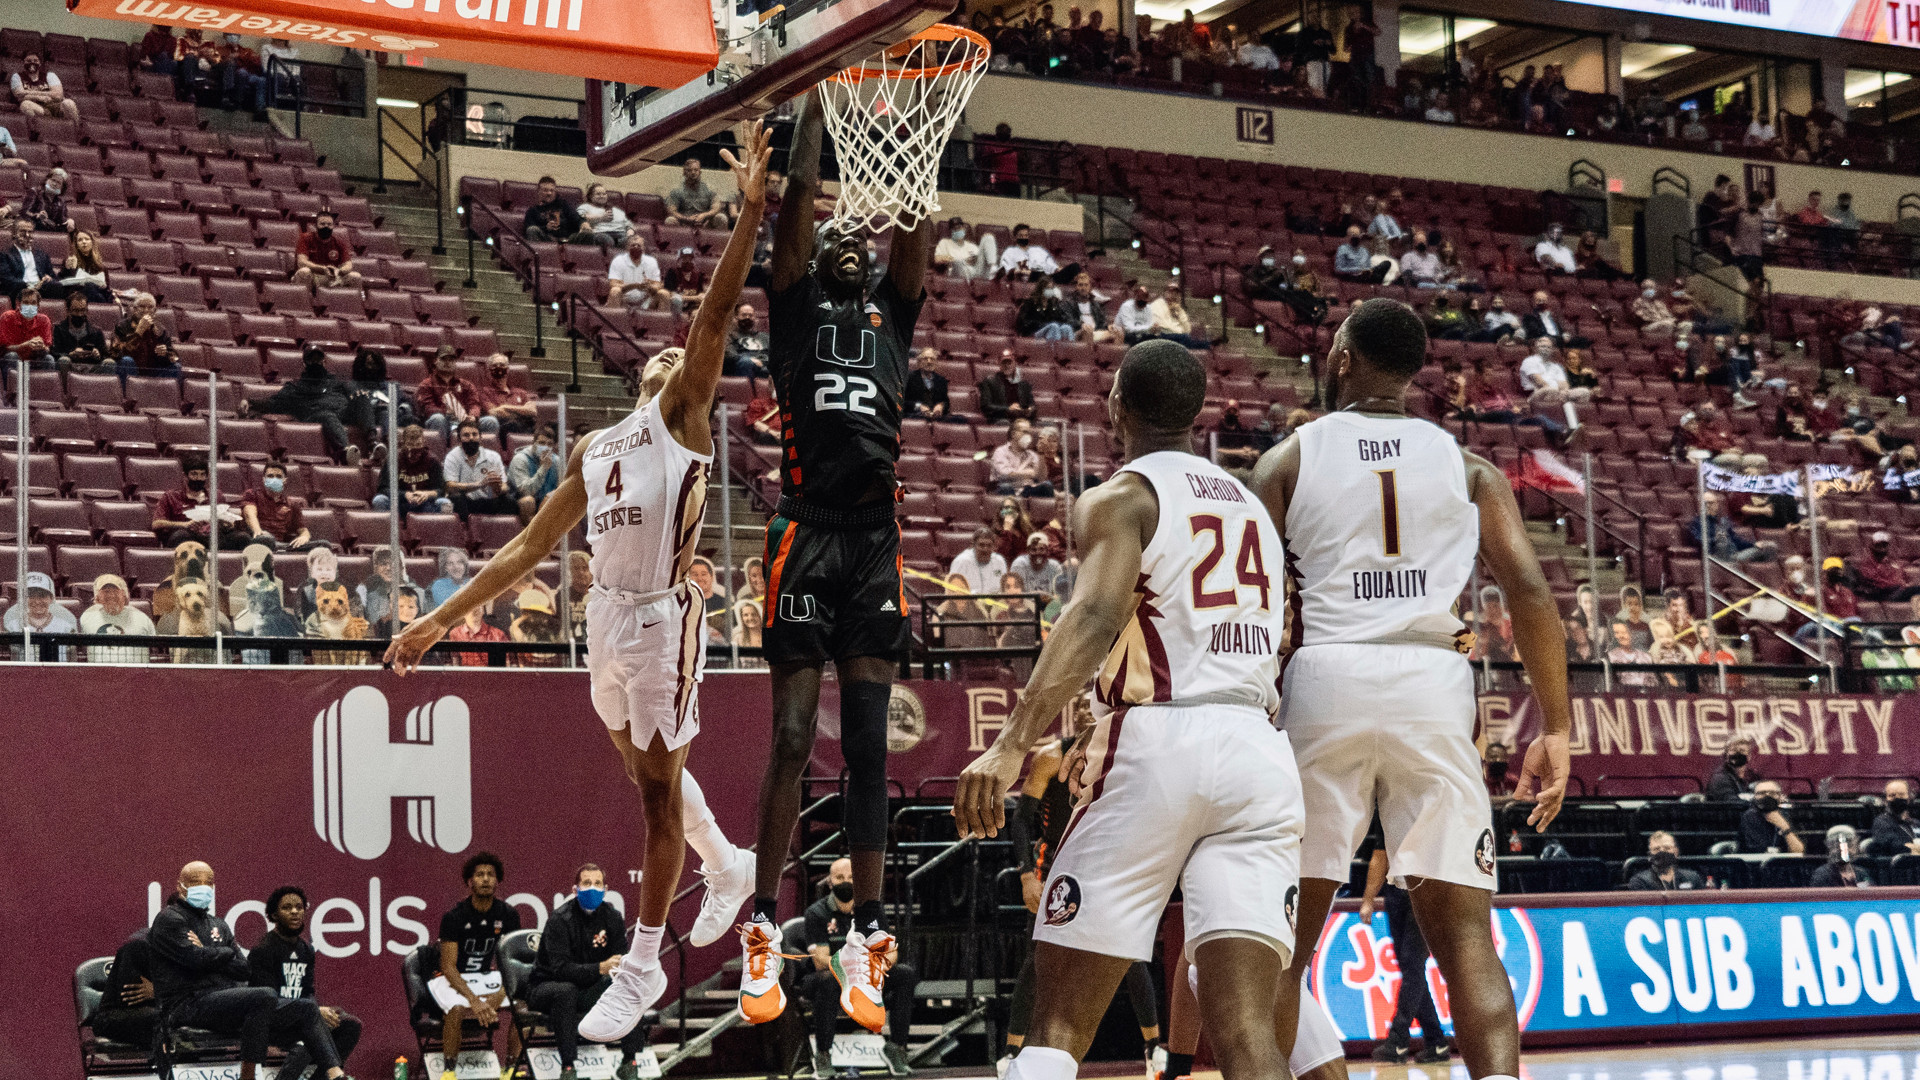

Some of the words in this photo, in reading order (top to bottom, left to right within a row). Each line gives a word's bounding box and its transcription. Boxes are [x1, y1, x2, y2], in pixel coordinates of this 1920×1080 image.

[1243, 111, 1267, 140] 112
[816, 324, 876, 368] U
[814, 373, 877, 416] 22
[1358, 439, 1401, 462] GRAY
[605, 460, 624, 502] 4
[1186, 472, 1247, 504] CALHOUN
[594, 506, 643, 534] STATE
[1371, 468, 1402, 557] 1
[1186, 512, 1271, 612] 24
[1353, 569, 1427, 601] EQUALITY
[465, 956, 484, 971] 5
[1562, 921, 1609, 1018] A
[1624, 916, 1756, 1014] SUB
[456, 1056, 494, 1073] yStar
